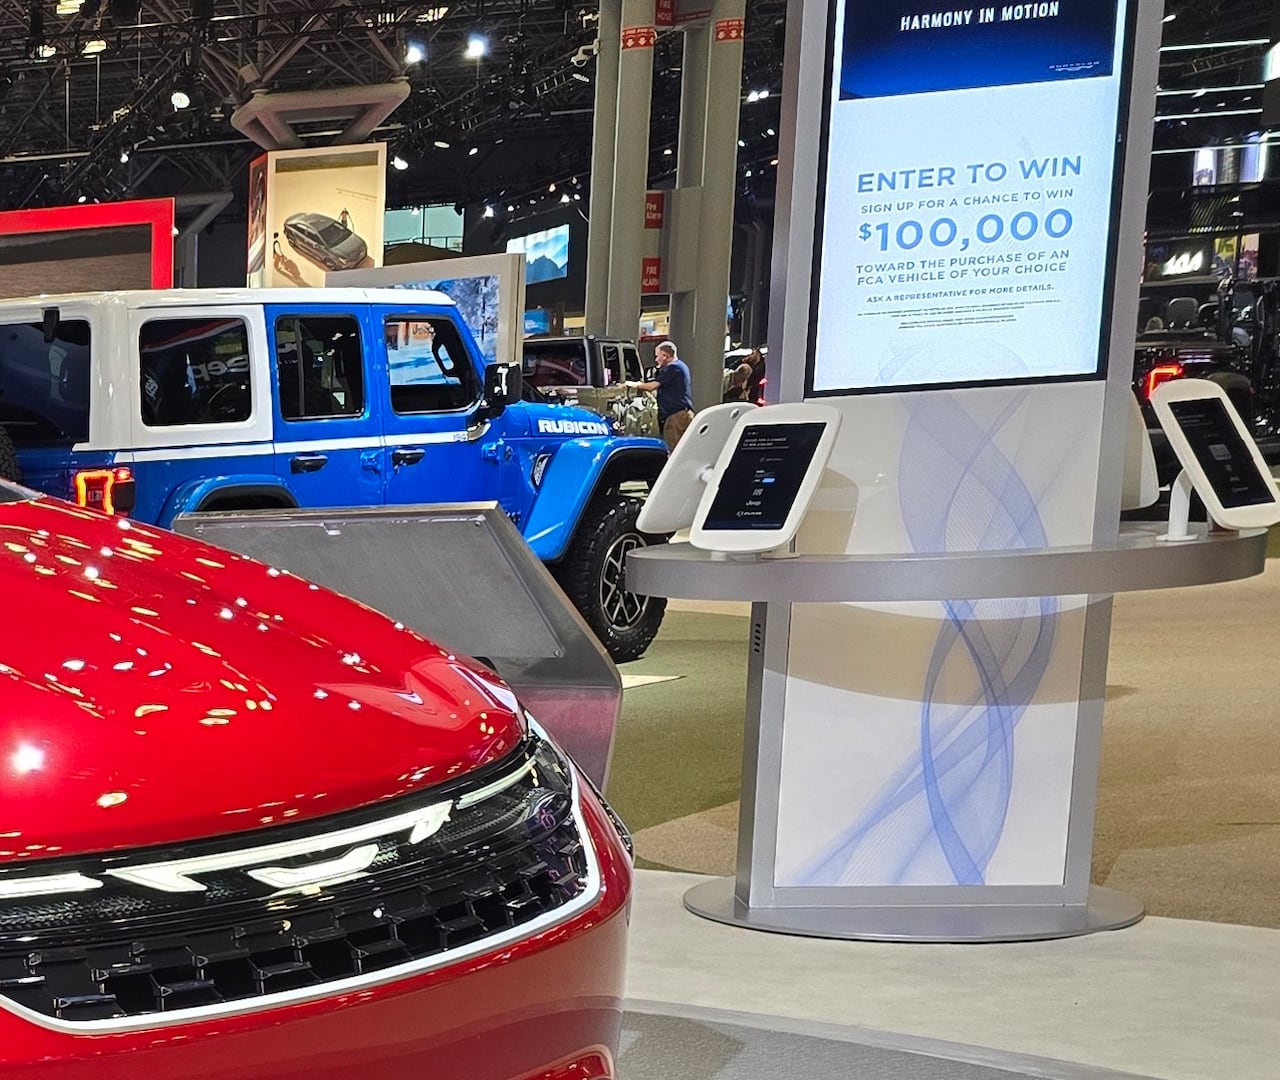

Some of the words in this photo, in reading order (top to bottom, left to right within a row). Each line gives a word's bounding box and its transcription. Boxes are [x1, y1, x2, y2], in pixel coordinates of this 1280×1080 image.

[900, 10, 972, 31] HARMONY
[979, 8, 995, 23] IN
[1001, 1, 1059, 22] MOTION
[858, 166, 956, 193] ENTER
[966, 163, 1007, 184] TO
[1019, 155, 1081, 180] WIN
[860, 203, 892, 214] SIGN
[897, 201, 914, 211] UP
[918, 199, 945, 209] FOR
[949, 198, 958, 207] A
[963, 192, 1019, 206] CHANCE
[1023, 191, 1041, 201] TO
[1046, 188, 1074, 199] WIN
[858, 208, 1073, 252] $100,000
[856, 261, 915, 274] TOWARD
[920, 259, 945, 270] THE
[950, 252, 1022, 267] PURCHASE
[1027, 251, 1046, 261] OF
[1050, 249, 1070, 260] AN
[857, 276, 884, 286] FCA
[888, 270, 946, 283] VEHICLE
[949, 269, 968, 279] OF
[973, 266, 1010, 278] YOUR
[1015, 261, 1067, 274] CHOICE
[894, 289, 968, 301] REPRESENTATIVE
[969, 287, 987, 296] FOR
[989, 285, 1014, 295] MORE
[537, 419, 609, 436] RUBICON
